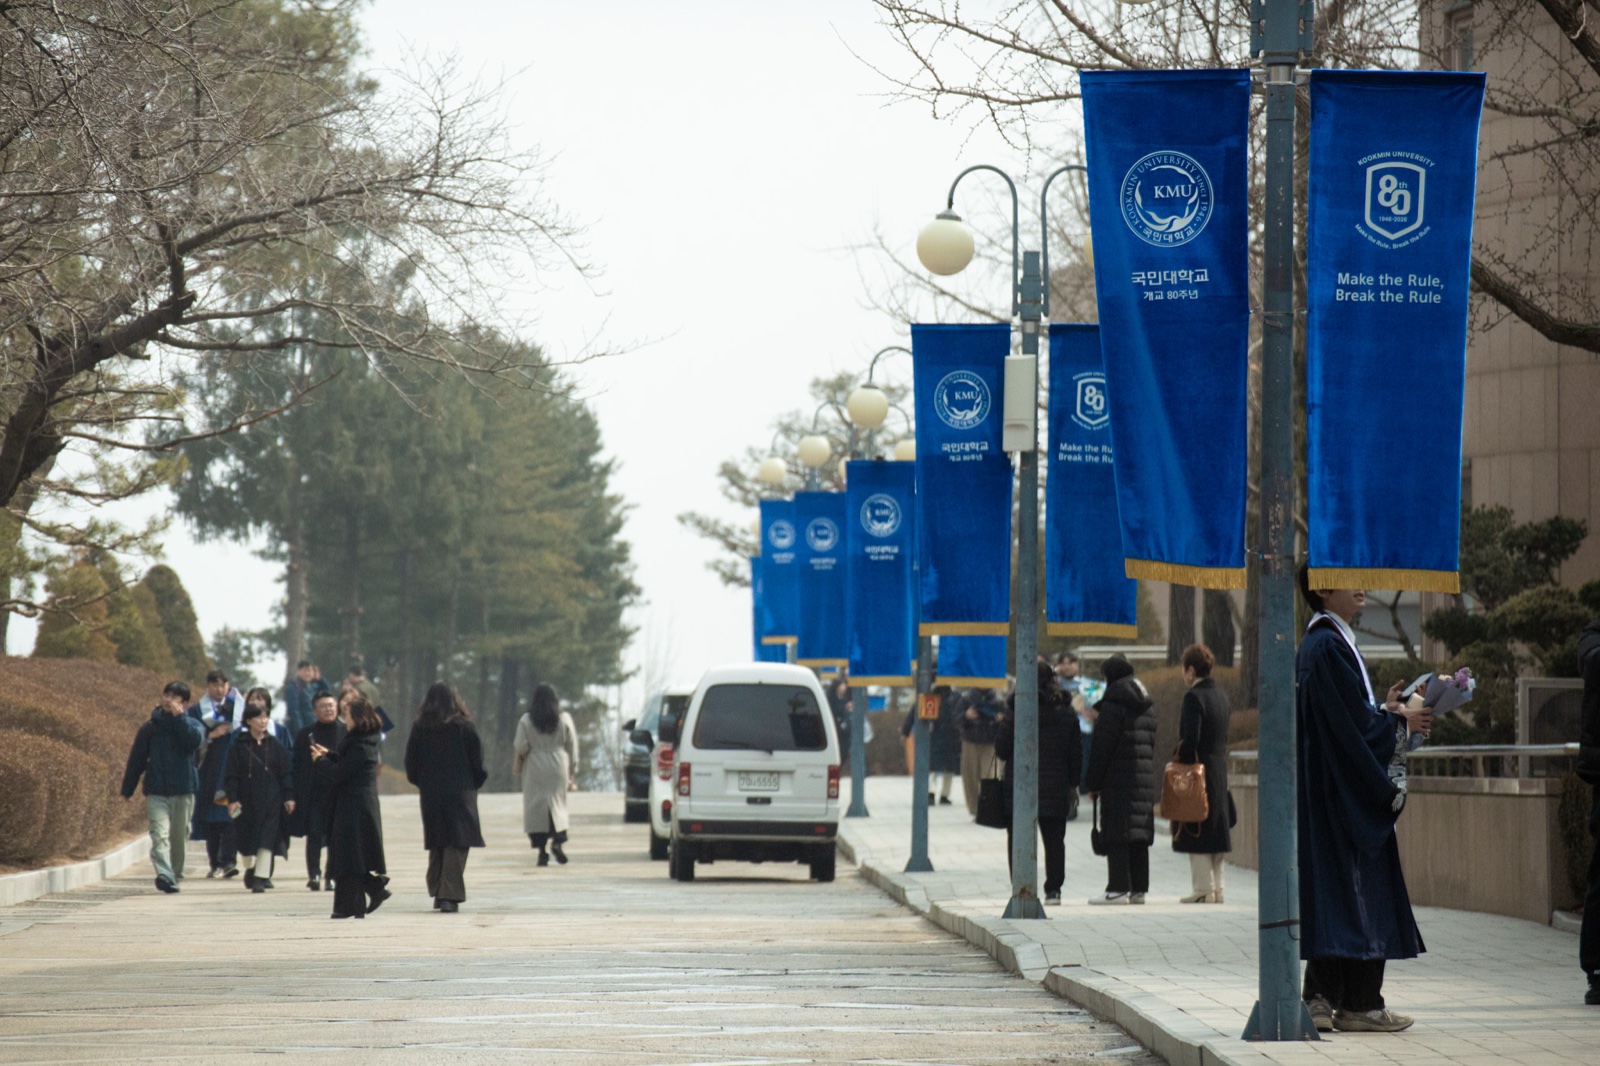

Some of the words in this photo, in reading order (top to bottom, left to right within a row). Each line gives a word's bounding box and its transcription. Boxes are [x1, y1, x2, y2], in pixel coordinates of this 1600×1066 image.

[1357, 151, 1391, 166] KOOKMIN
[1392, 151, 1435, 168] UNIVERSITY
[1125, 174, 1139, 226] KOOKMIN
[1137, 155, 1197, 174] UNIVERSITY
[1195, 201, 1208, 222] 1946
[1154, 184, 1192, 198] KMU
[1143, 226, 1195, 243] 국민대학교
[1355, 223, 1368, 238] Make
[1367, 234, 1377, 244] the
[1392, 240, 1409, 249] Break
[1409, 235, 1419, 244] the
[1418, 225, 1431, 237] Rule
[1131, 268, 1209, 286] 국민대학교
[1337, 272, 1374, 285] Make
[1378, 273, 1403, 286] the
[1408, 274, 1444, 290] Rule,
[1144, 290, 1164, 301] 개교
[1167, 289, 1198, 300] 80주년
[1336, 288, 1375, 302] Break
[1379, 289, 1404, 302] the
[1409, 290, 1441, 303] Rule
[954, 391, 978, 400] KMU
[1059, 442, 1082, 452] Make
[1084, 444, 1099, 453] the
[1058, 452, 1083, 462] Break
[1085, 453, 1099, 463] the
